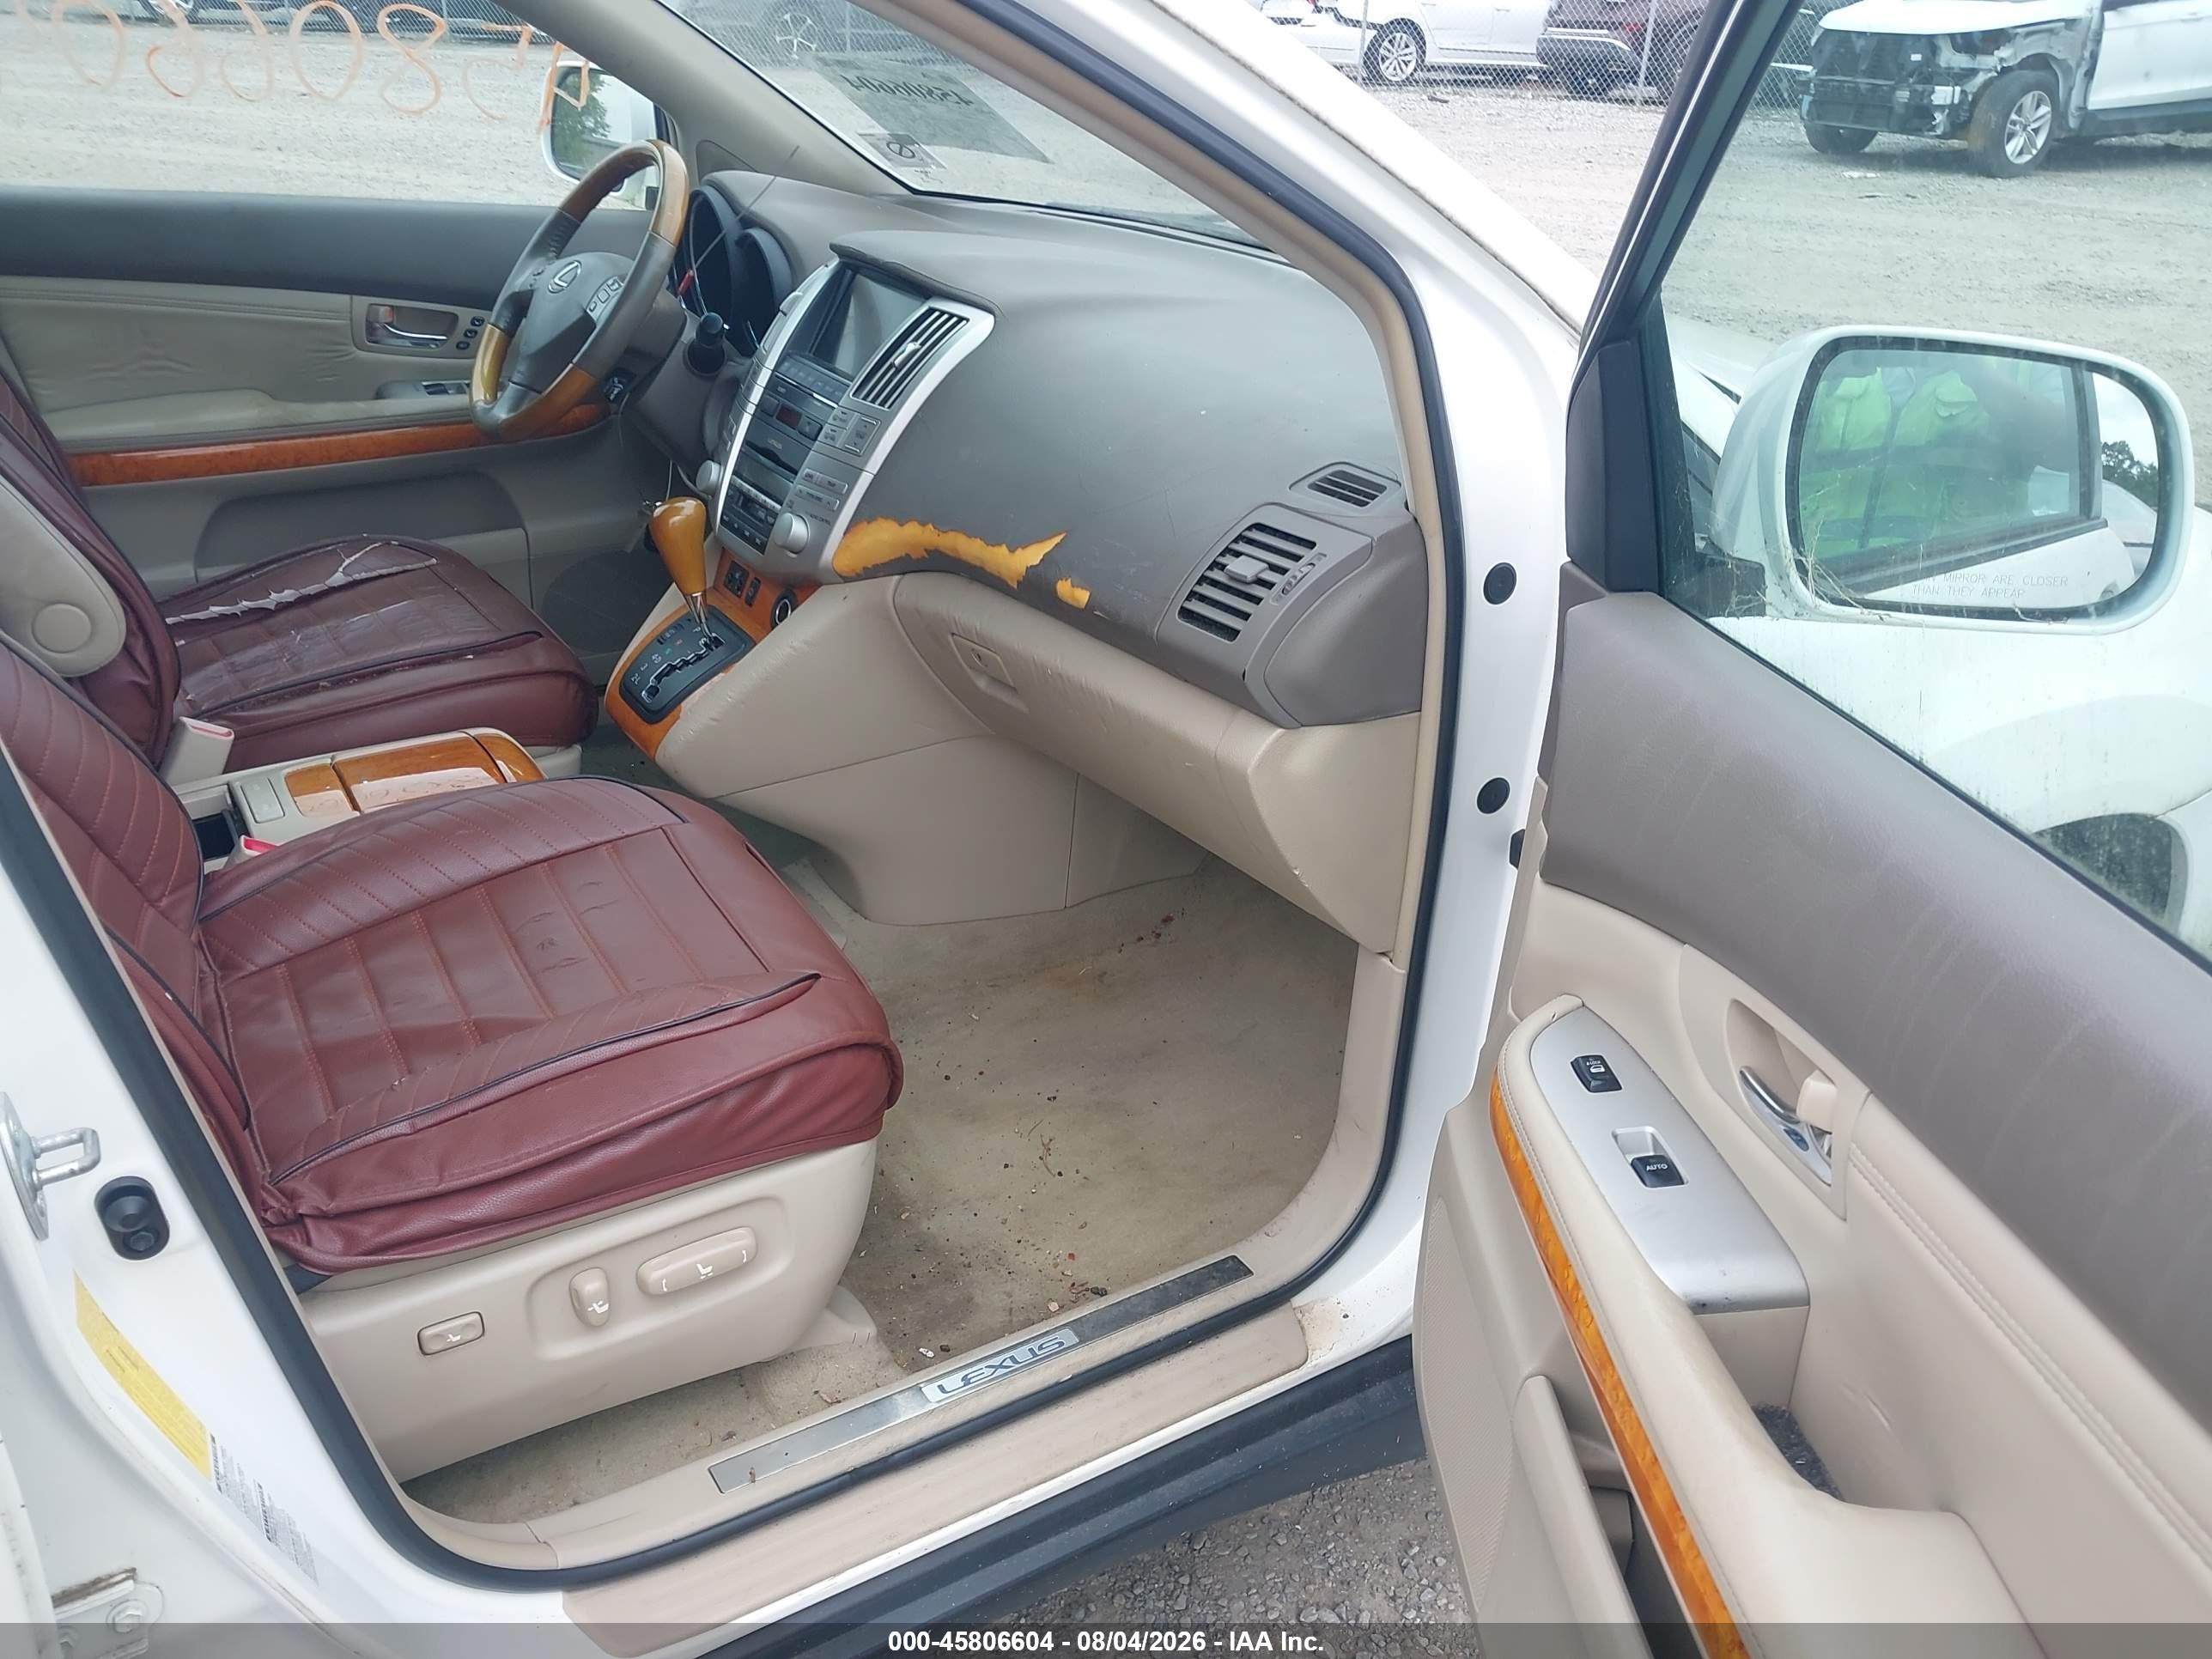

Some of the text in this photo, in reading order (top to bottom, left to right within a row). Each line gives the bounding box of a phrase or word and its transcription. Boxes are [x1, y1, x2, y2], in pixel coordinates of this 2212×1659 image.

[1943, 573, 1986, 583] MIRROR
[1992, 574, 2014, 586] ARE
[2022, 575, 2069, 587] CLOSER
[1912, 585, 2027, 599] THAN THEY APPEAR
[1646, 1163, 1668, 1172] AUTO
[936, 1335, 1066, 1395] LEXUS
